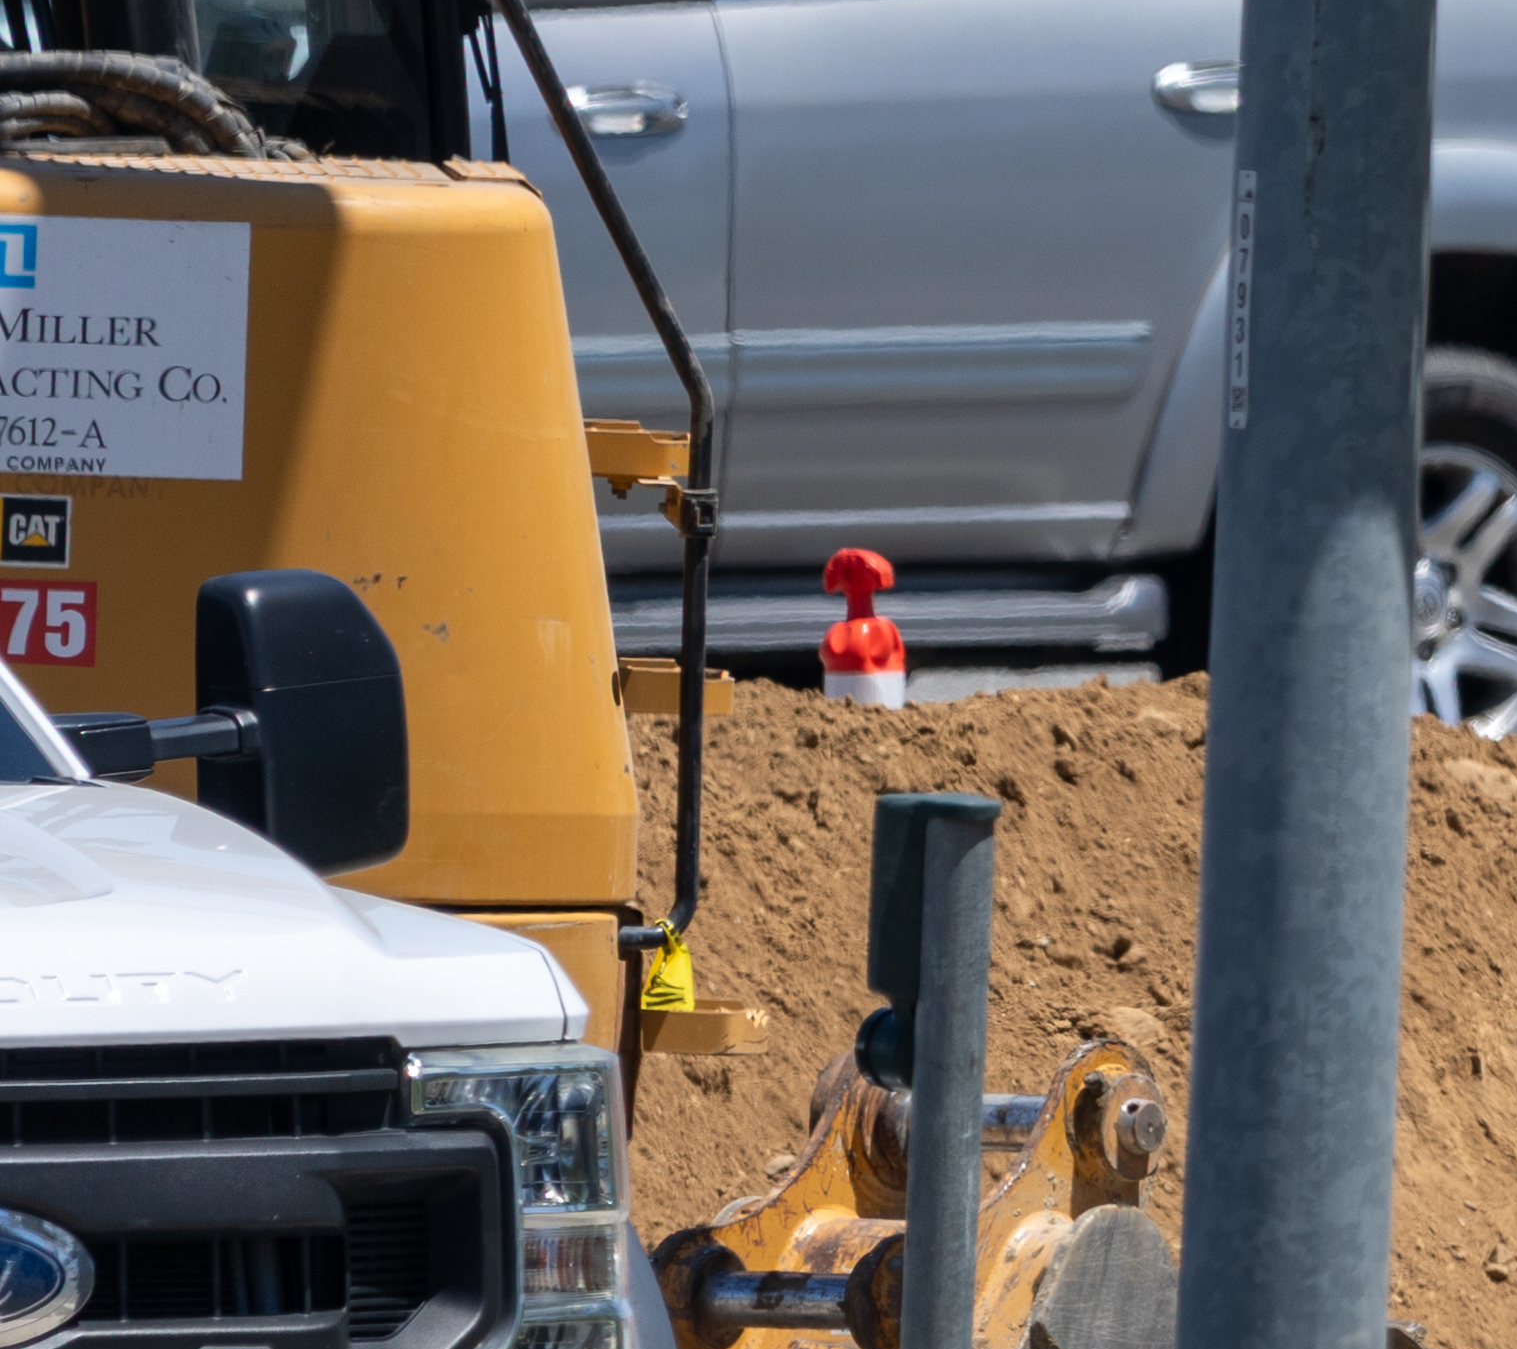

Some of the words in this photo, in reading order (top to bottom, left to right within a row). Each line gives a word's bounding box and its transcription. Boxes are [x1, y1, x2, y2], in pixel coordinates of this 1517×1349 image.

[0, 366, 144, 401] CTING
[7, 455, 107, 472] COMPANY
[9, 512, 62, 547] CAT
[1, 588, 87, 658] 75
